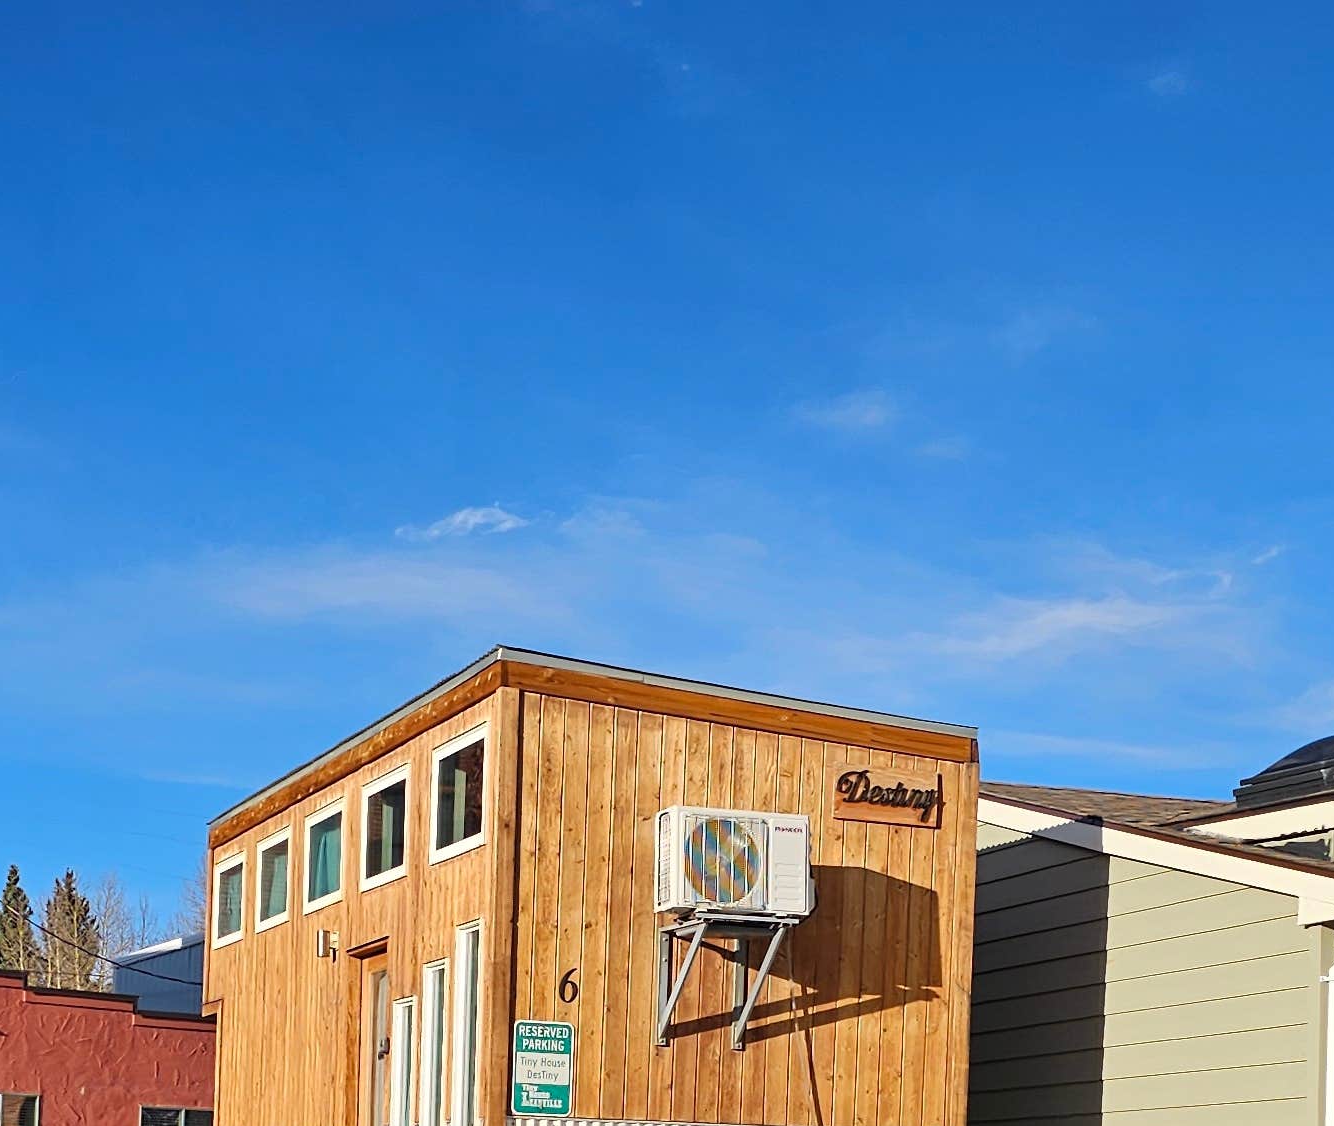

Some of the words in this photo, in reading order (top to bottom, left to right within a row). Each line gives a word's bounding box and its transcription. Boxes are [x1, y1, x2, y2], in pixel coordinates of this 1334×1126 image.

[836, 769, 939, 823] Destiny
[559, 967, 578, 1004] 6
[519, 1025, 569, 1039] RESERVED
[522, 1038, 565, 1052] PARKING
[520, 1056, 537, 1068] Tiny
[540, 1057, 567, 1068] House
